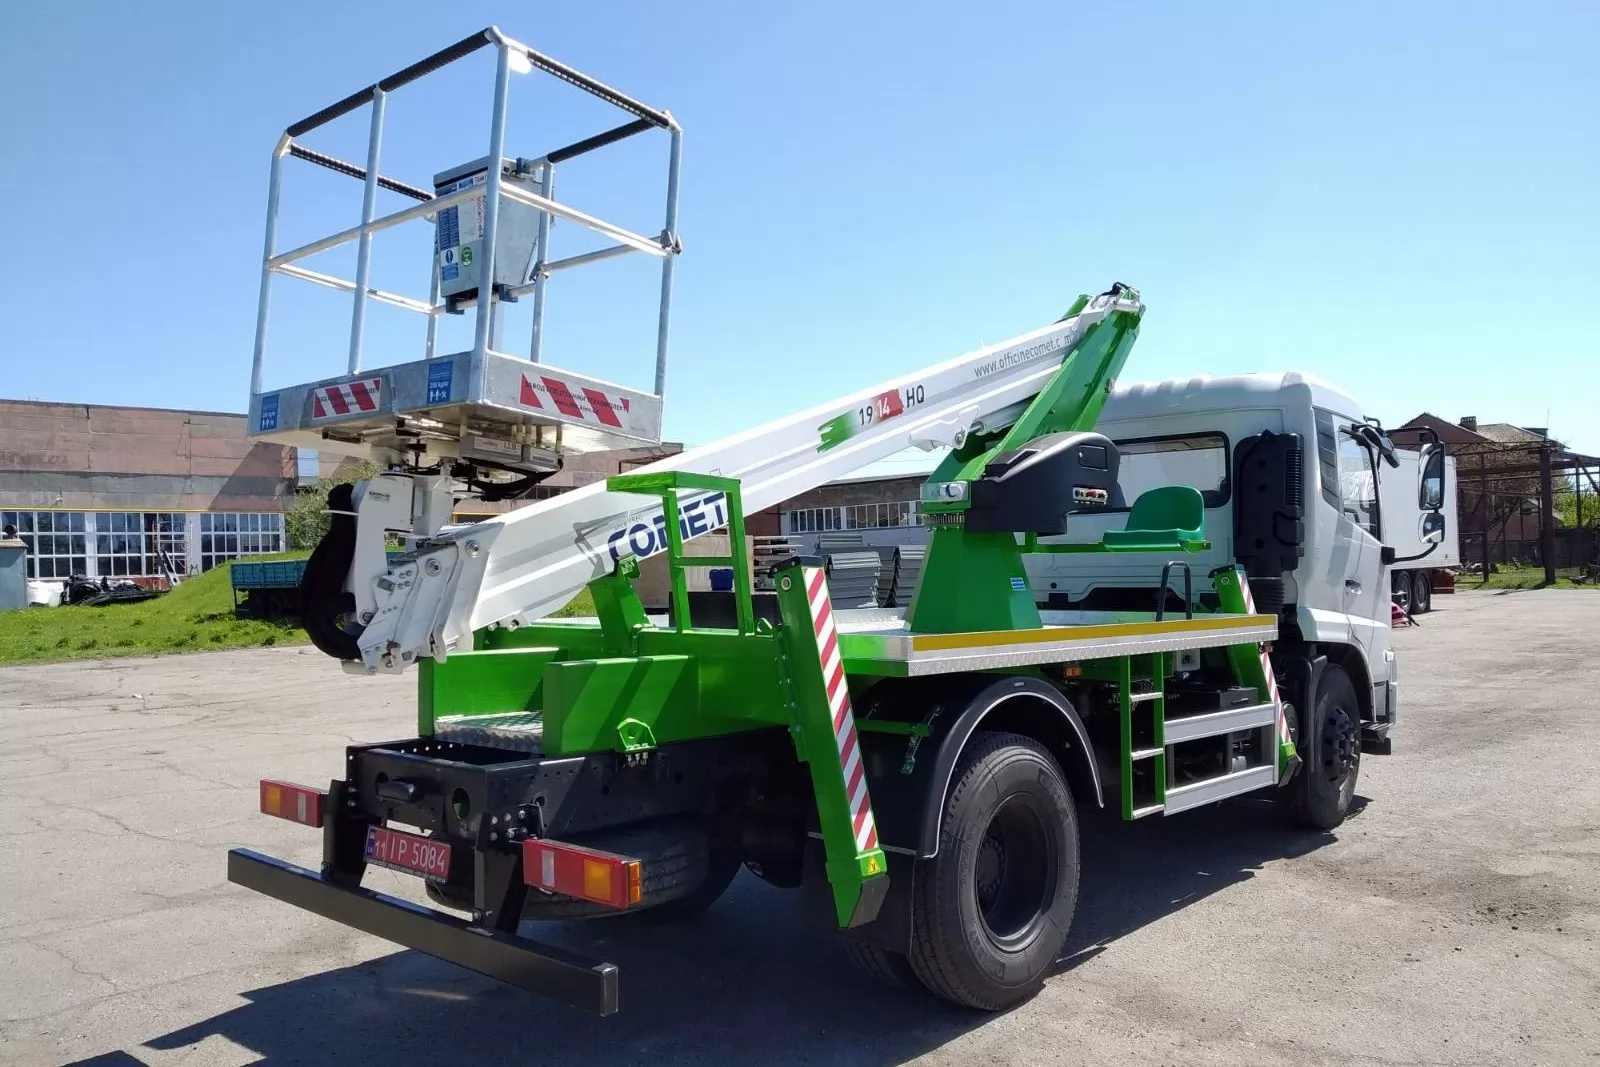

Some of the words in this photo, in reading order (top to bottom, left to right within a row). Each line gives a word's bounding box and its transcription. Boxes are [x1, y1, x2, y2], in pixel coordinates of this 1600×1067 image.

[974, 334, 1072, 378] www.officinecomet.cm
[906, 384, 925, 408] HQ
[412, 842, 445, 872] 5084
